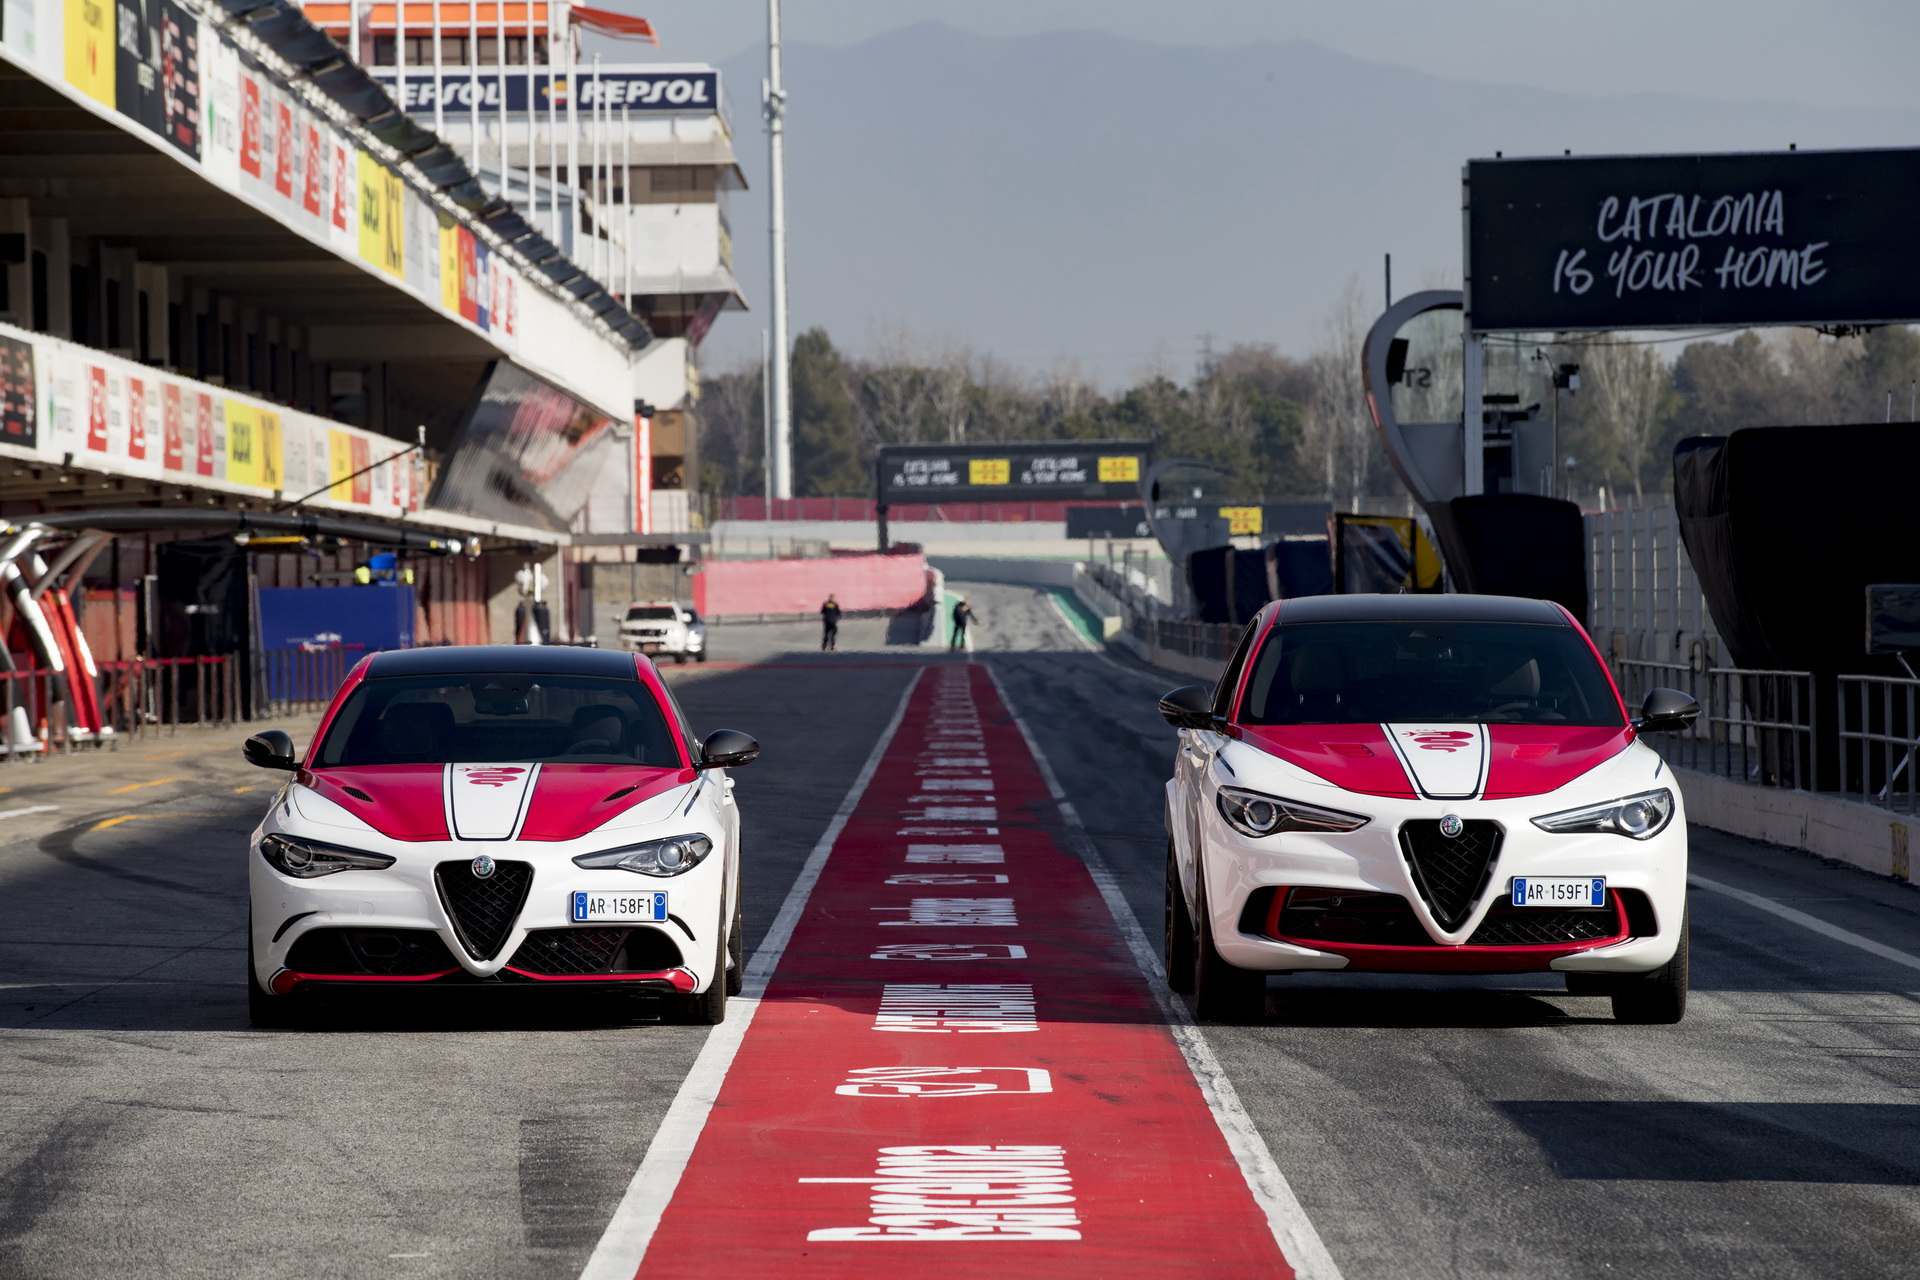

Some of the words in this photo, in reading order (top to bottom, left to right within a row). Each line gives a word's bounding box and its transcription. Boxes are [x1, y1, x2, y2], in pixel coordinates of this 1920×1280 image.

[580, 79, 709, 104] REPSOL
[1597, 189, 1784, 242] CATALONIA
[1553, 248, 1594, 295] IS
[1607, 243, 1703, 298] YOUR
[1714, 241, 1829, 290] HOME
[798, 1145, 1082, 1241] Barcelona
